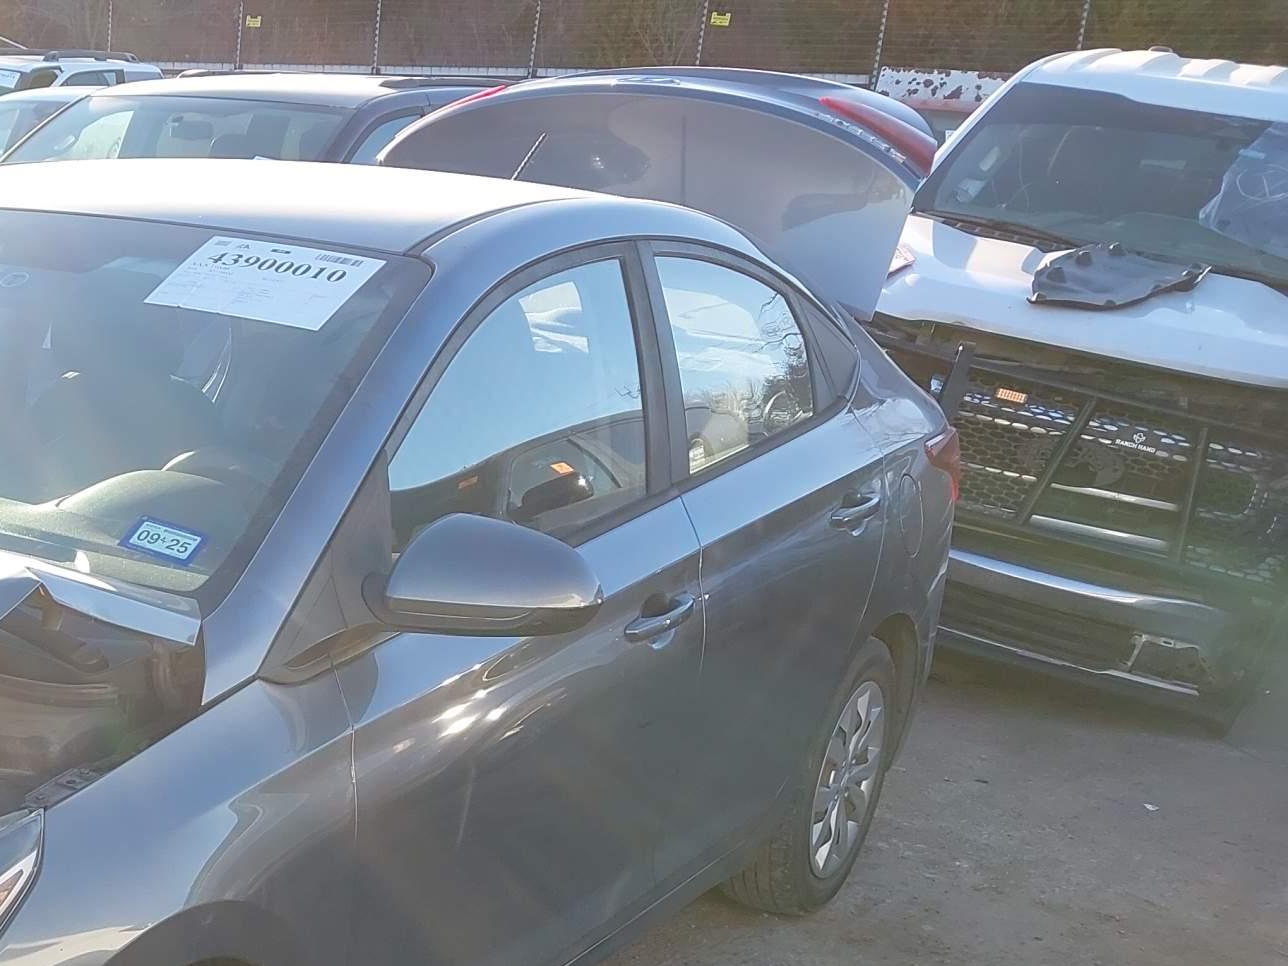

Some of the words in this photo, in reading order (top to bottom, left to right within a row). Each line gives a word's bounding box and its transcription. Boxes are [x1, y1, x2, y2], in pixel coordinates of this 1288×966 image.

[208, 251, 347, 283] 43900010
[136, 529, 161, 545] 09
[165, 538, 192, 554] 25
